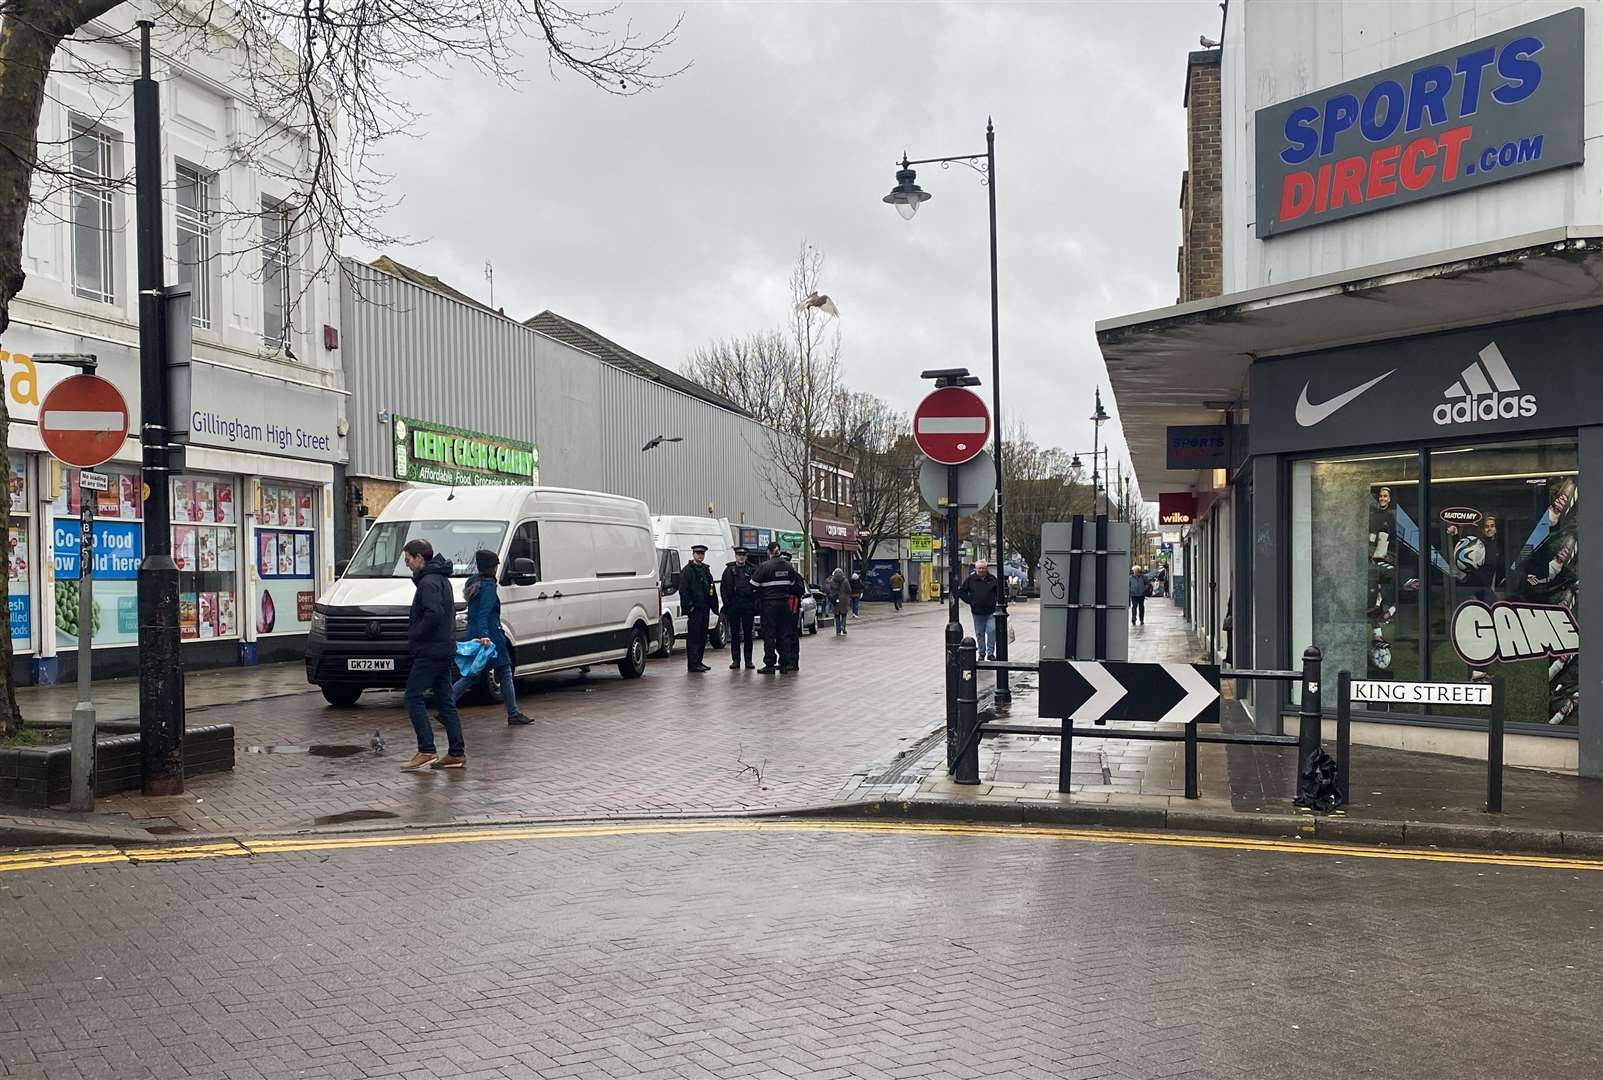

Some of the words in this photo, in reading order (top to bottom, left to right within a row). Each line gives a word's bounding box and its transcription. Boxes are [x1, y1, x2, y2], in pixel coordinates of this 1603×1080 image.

[1279, 36, 1545, 166] SPORTS
[1432, 391, 1537, 425] adidas
[192, 411, 262, 441] Gillingham
[266, 423, 292, 449] High
[296, 428, 330, 451] Street
[413, 429, 453, 465] KENT
[1172, 437, 1225, 449] SPORTS
[420, 466, 453, 482] Affordable
[1162, 511, 1189, 523] wilko
[1444, 511, 1467, 520] MATCH
[1467, 512, 1478, 520] MY
[102, 531, 133, 549] food
[112, 553, 141, 571] here
[1455, 604, 1579, 661] GAME
[351, 660, 373, 669] GK72
[1355, 683, 1406, 700] KING
[1413, 685, 1487, 702] STREET
